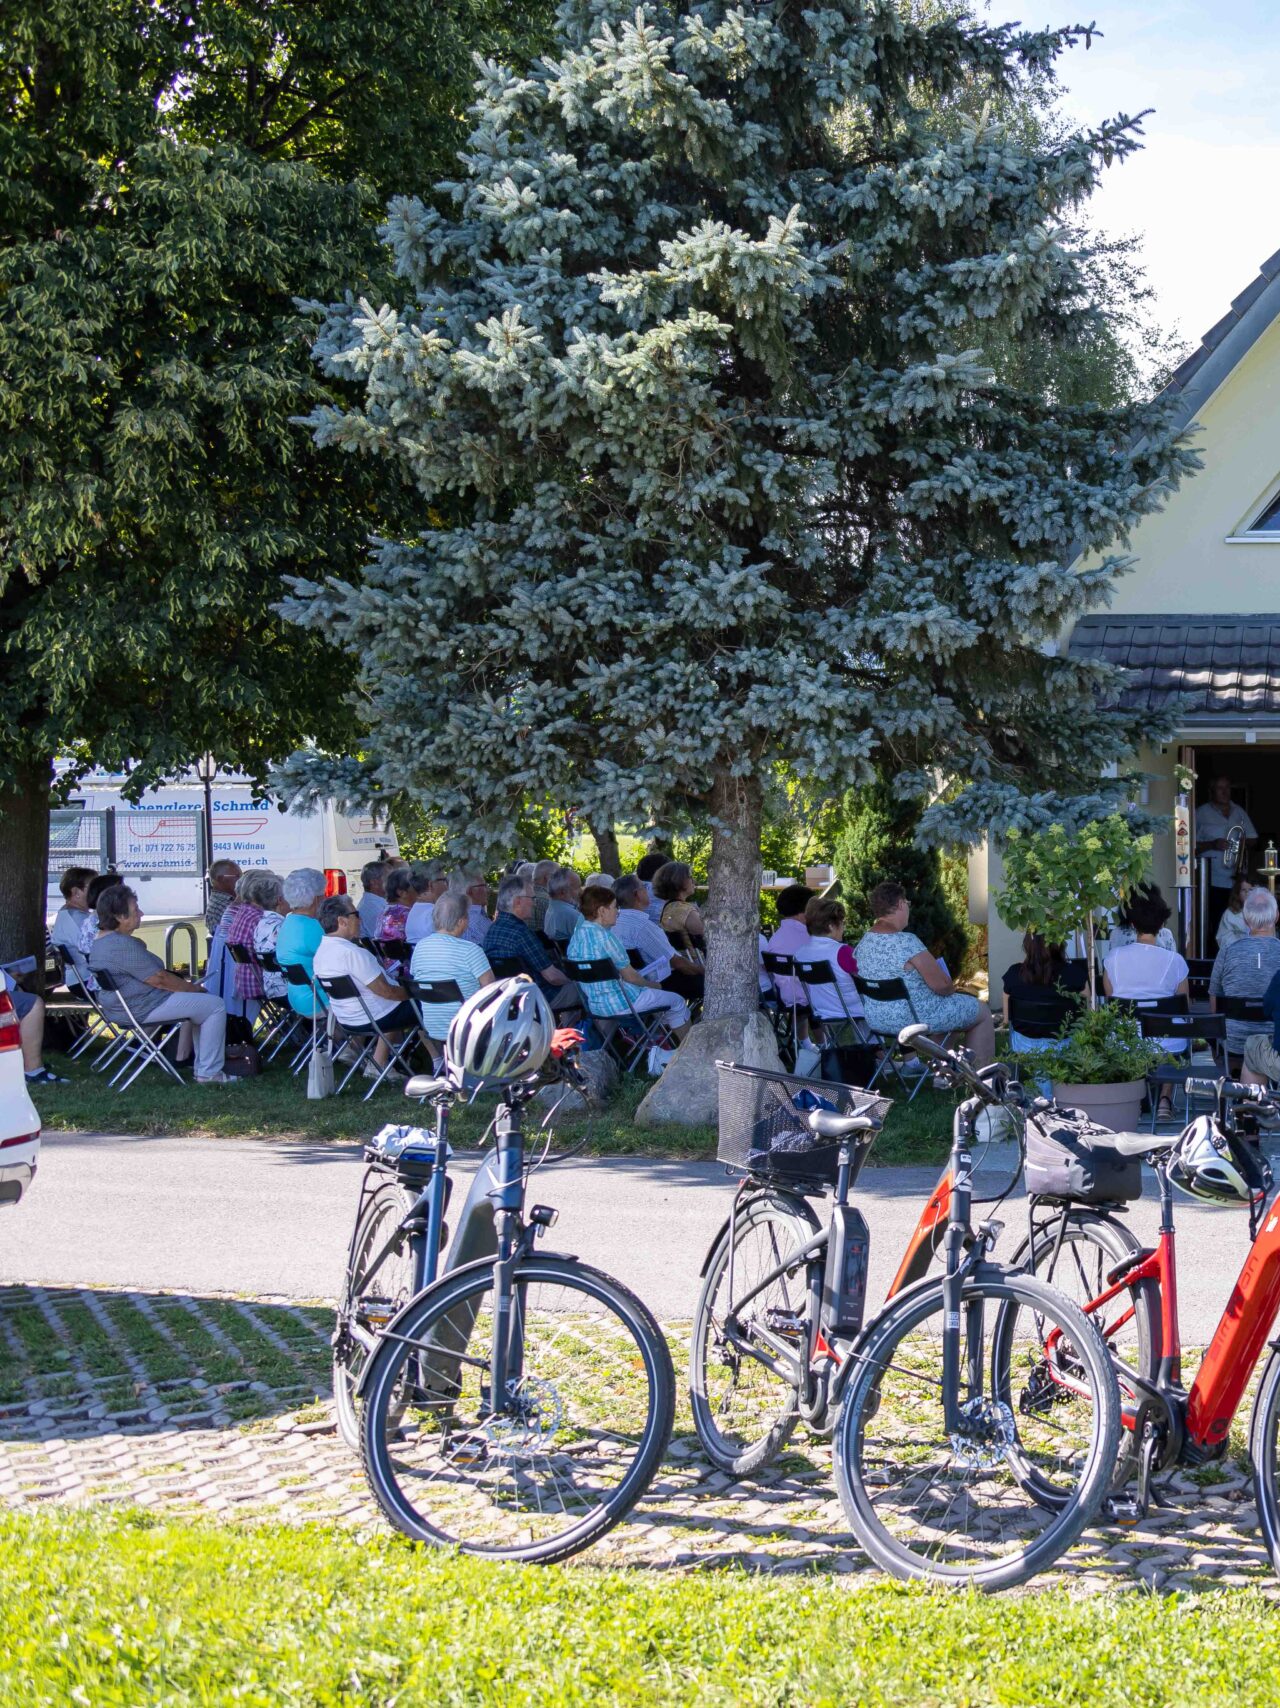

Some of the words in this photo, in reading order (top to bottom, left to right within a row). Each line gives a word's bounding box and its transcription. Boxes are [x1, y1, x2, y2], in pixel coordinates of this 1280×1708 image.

[160, 843, 174, 852] 722
[213, 842, 231, 851] 9443
[233, 842, 266, 850] Widnau
